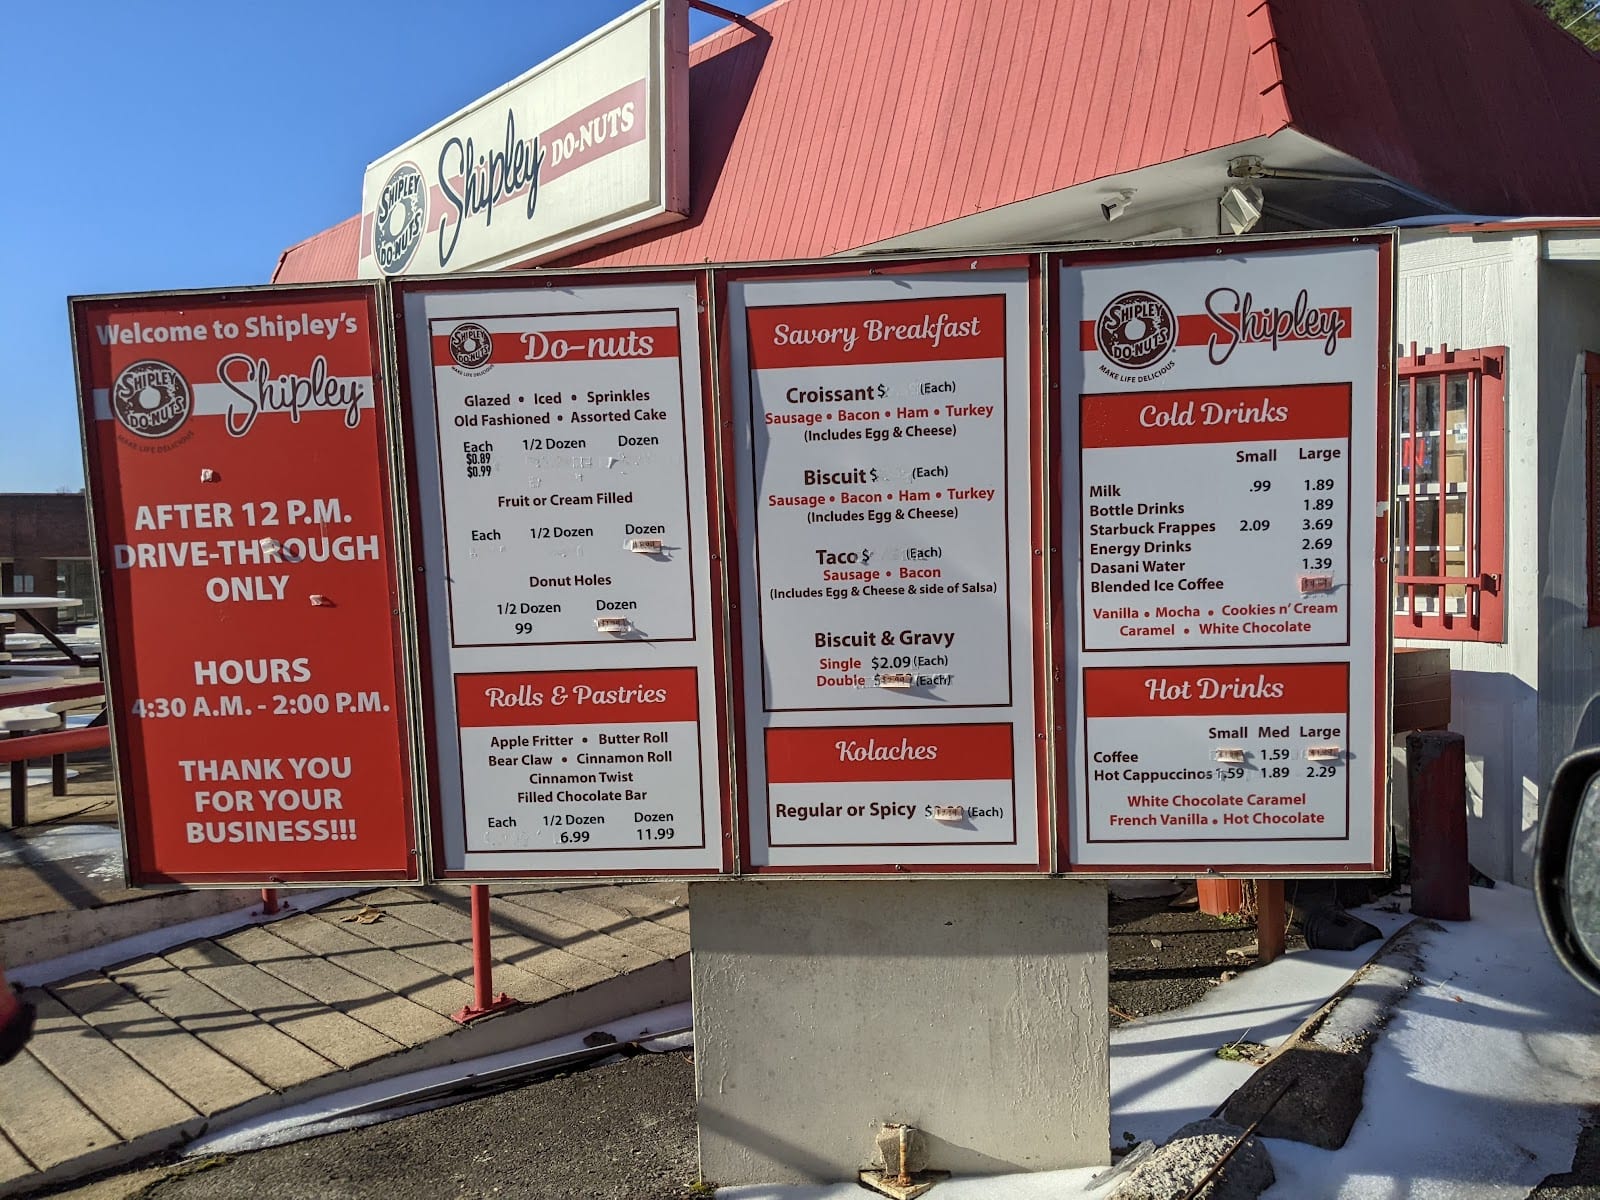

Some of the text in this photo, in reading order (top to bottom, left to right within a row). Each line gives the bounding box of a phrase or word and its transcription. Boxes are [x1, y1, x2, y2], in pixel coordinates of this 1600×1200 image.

[439, 101, 634, 268] Shipley DO-NUTS
[380, 175, 420, 223] SHIPLEY
[1106, 304, 1162, 329] SHIPLEY
[96, 312, 357, 345] Welcome to Shipley's
[773, 313, 981, 352] Savory Breakfast
[1205, 288, 1344, 366] Shipley
[452, 330, 484, 345] SHIPLEY
[520, 331, 654, 361] Do-nuts
[1099, 360, 1176, 383] MAKE LIFE DELICIOUS
[117, 371, 176, 398] SHIPLEY
[786, 381, 956, 404] Croissant (Each)
[218, 353, 364, 436] Shipley
[464, 390, 650, 406] Glazed Iced Sprinkles
[454, 409, 666, 427] Old Fashioned Assorted Cake
[765, 403, 994, 426] Sausage Bacon Ham Turkey
[1139, 398, 1288, 428] Cold Drinks
[804, 424, 957, 442] (Includes Egg & Cheese)
[464, 435, 658, 452] Each 1/2 Dozen Dozen
[466, 454, 490, 465] $0.89
[1236, 448, 1341, 462] Small Large
[467, 466, 491, 479] $0.99
[804, 466, 948, 485] Biscuit (Each)
[1090, 479, 1334, 497] Milk .99 1.89
[498, 492, 632, 508] Fruit or Cream Filled
[1090, 499, 1333, 516] Bottle Drinks 1.89
[135, 498, 351, 531] AFTER 12 P.M.
[1090, 519, 1333, 535] Starbuck Frappes 2.09 3.69
[113, 535, 379, 569] DRIVE-THROUGH
[816, 547, 942, 565] Taco (Each)
[1091, 539, 1332, 556] Energy Drinks 2.69
[1091, 558, 1332, 574] Dasani Water 1.39
[206, 575, 290, 602] ONLY
[530, 574, 612, 588] Donut Holes
[1091, 578, 1224, 592] Blended Ice Coffee
[770, 582, 997, 600] (Includes Egg & Cheese & side of Salsa)
[1093, 607, 1138, 619] Vanilla
[1156, 606, 1200, 617] Mocha
[1222, 605, 1275, 616] Cookies
[1294, 603, 1338, 614] Cream
[1120, 622, 1311, 636] Caramel White Chocolate
[815, 630, 955, 648] Biscuit & Gravy
[194, 657, 311, 685] HOURS
[819, 655, 948, 671] Single $2.09 (Each)
[817, 675, 865, 687] Double
[1145, 675, 1284, 700] Hot Drinks
[485, 684, 667, 708] Rolls & Pastries
[131, 692, 390, 719] 4:30 A.M. 2:00 P.M.
[490, 732, 668, 750] Apple Fritter Butter Roll
[1209, 726, 1340, 739] Small Med Large
[489, 751, 672, 766] Bear Claw Cinnamon Roll
[835, 738, 937, 762] Kolaches
[1093, 749, 1290, 763] Coffee 1.59
[179, 756, 352, 782] THANK YOU
[530, 771, 633, 785] Cinnamon Twist
[1094, 766, 1336, 783] Hot Cappuccinos 1.89 2.29
[195, 789, 343, 813] FOR YOUR
[488, 812, 674, 828] Each 1/2 Dozen Dozen
[776, 802, 843, 820] Regular
[847, 805, 865, 816] or
[870, 802, 916, 820] Spicy
[967, 806, 1003, 819] (Each)
[1110, 812, 1324, 826] French Vanilla Hot Chocolate
[186, 819, 358, 844] BUSINESS!!!
[560, 828, 674, 844] 6.99 11.99
